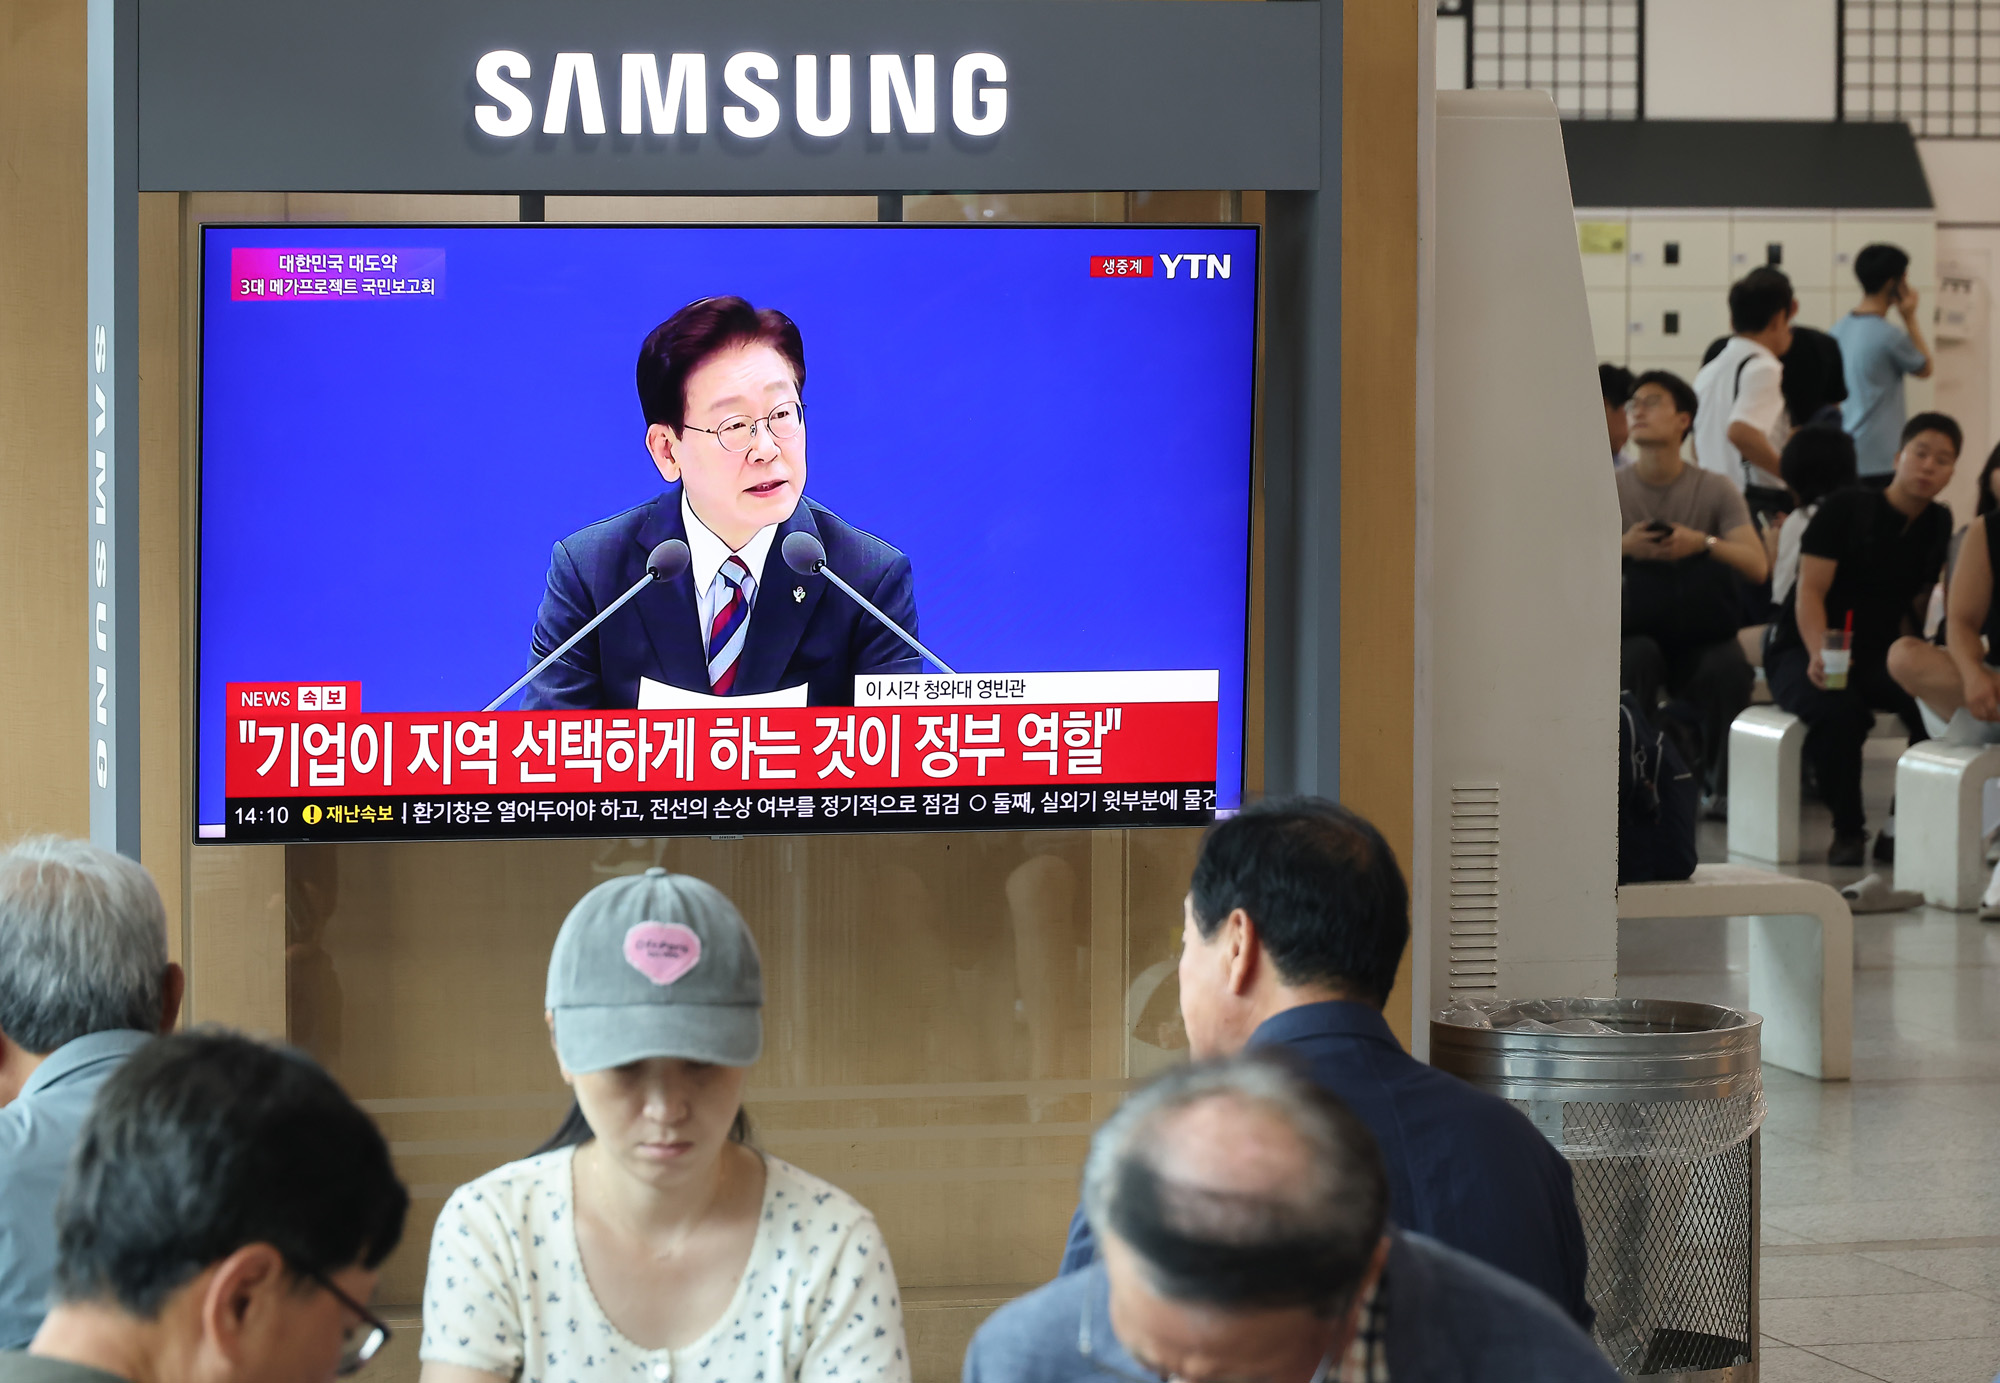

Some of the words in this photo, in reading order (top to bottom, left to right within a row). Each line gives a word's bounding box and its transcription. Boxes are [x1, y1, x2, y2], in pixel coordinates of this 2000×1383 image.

[474, 50, 1007, 137] SAMSUNG
[279, 254, 345, 274] 대한민국
[348, 254, 398, 273] 대도약
[1102, 258, 1142, 275] 생중계
[1159, 254, 1231, 279] YTN
[240, 278, 265, 296] 3대
[269, 278, 359, 296] 메가프로젝트
[361, 278, 435, 296] 국민보고회
[94, 323, 109, 790] SAMSUNG
[241, 691, 291, 707] NEWS
[302, 690, 342, 707] 속보
[866, 681, 882, 700] 이
[886, 680, 920, 700] 시각
[923, 679, 972, 700] 청와대
[977, 678, 1026, 699] 영빈관
[239, 719, 393, 788] "기업이
[406, 720, 498, 785] 지역
[511, 717, 695, 783] 선택하게
[709, 716, 801, 781] 하는
[812, 714, 901, 780] 것이
[914, 713, 1005, 778] 정부
[1017, 707, 1122, 776] 역할"
[235, 806, 289, 825] 14:10
[326, 804, 394, 824] 재난속보
[412, 801, 493, 824] 환기창은
[497, 799, 597, 823] 열어두어야
[600, 798, 645, 822] 하고,
[649, 797, 708, 820] 전선의
[712, 796, 753, 819] 손상
[757, 795, 816, 818] 여부를
[820, 794, 918, 816] 정기적으로
[922, 792, 960, 815] 점검
[992, 791, 1036, 814] 둘째,
[1040, 790, 1097, 813] 실외기
[1102, 789, 1178, 812] 윗부분에
